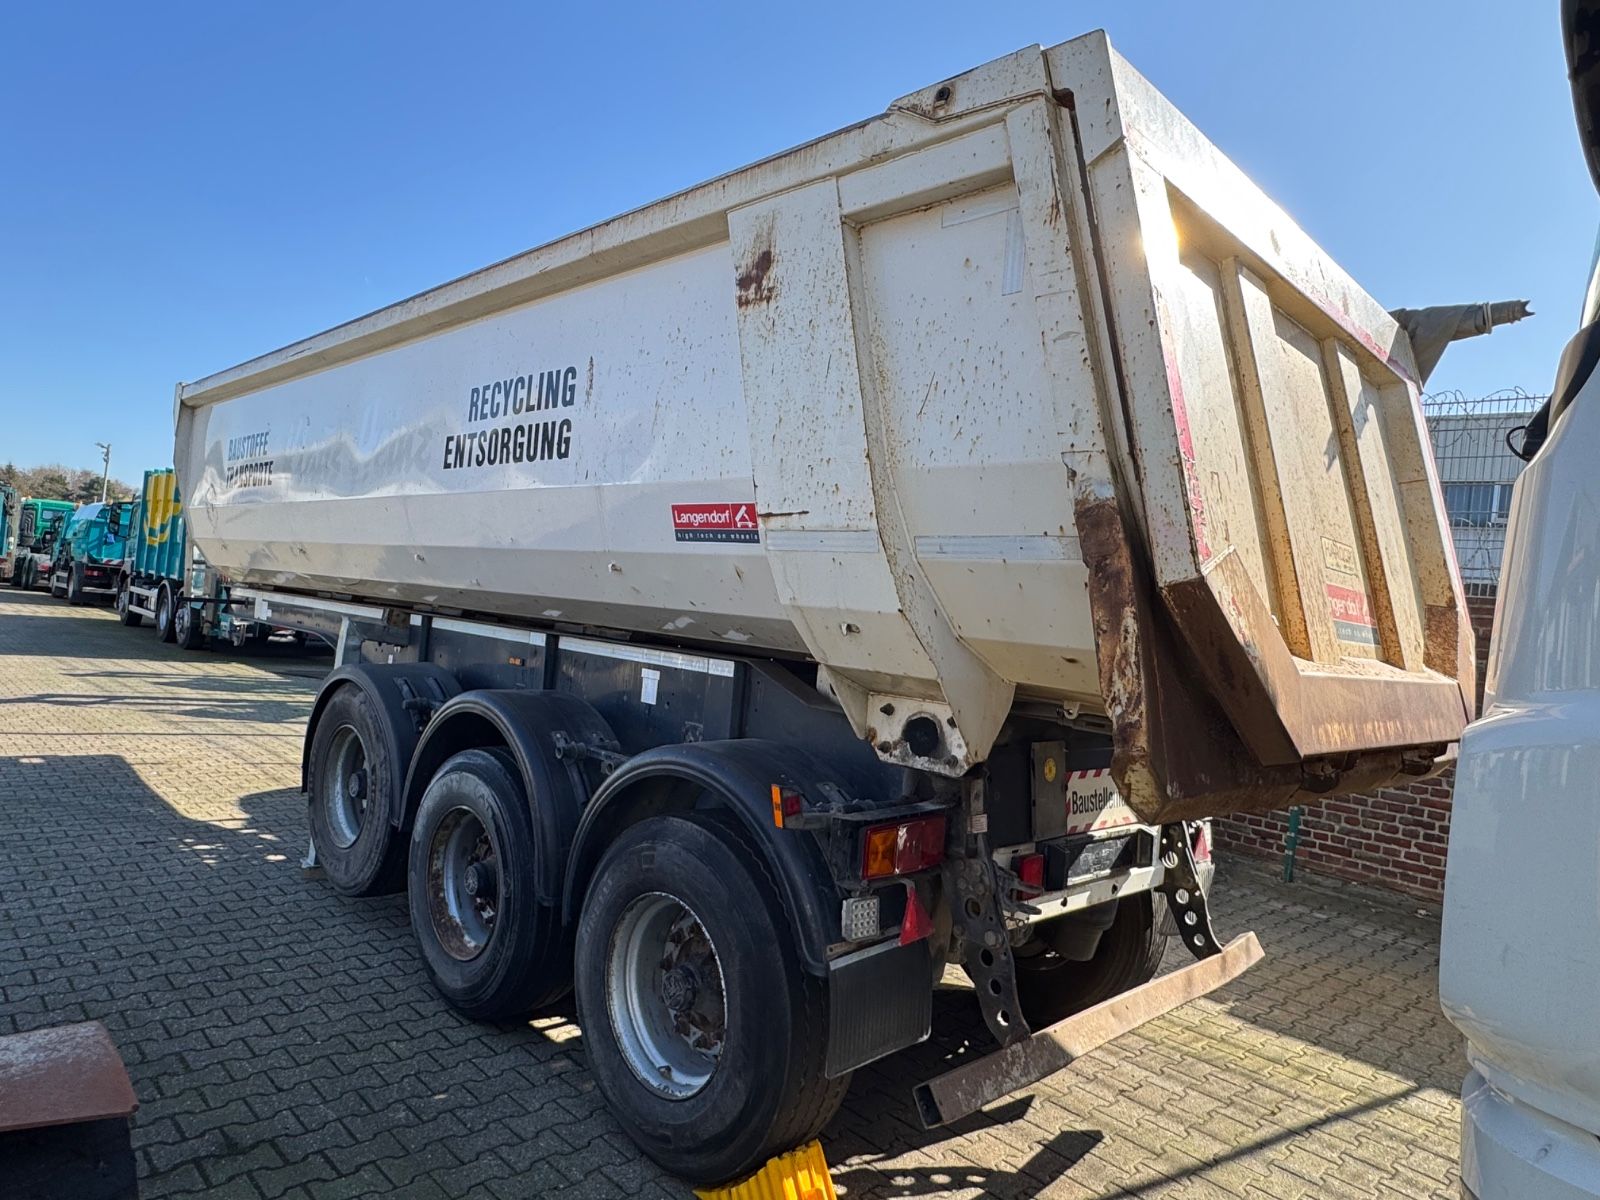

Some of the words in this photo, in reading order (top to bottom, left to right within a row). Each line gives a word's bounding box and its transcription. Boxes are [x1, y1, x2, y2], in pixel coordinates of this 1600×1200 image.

[468, 366, 577, 422] RECYCLING
[228, 431, 269, 461] BAUSTOFFE
[443, 418, 572, 469] ENTSORGUNG
[674, 510, 730, 526] Langendorf
